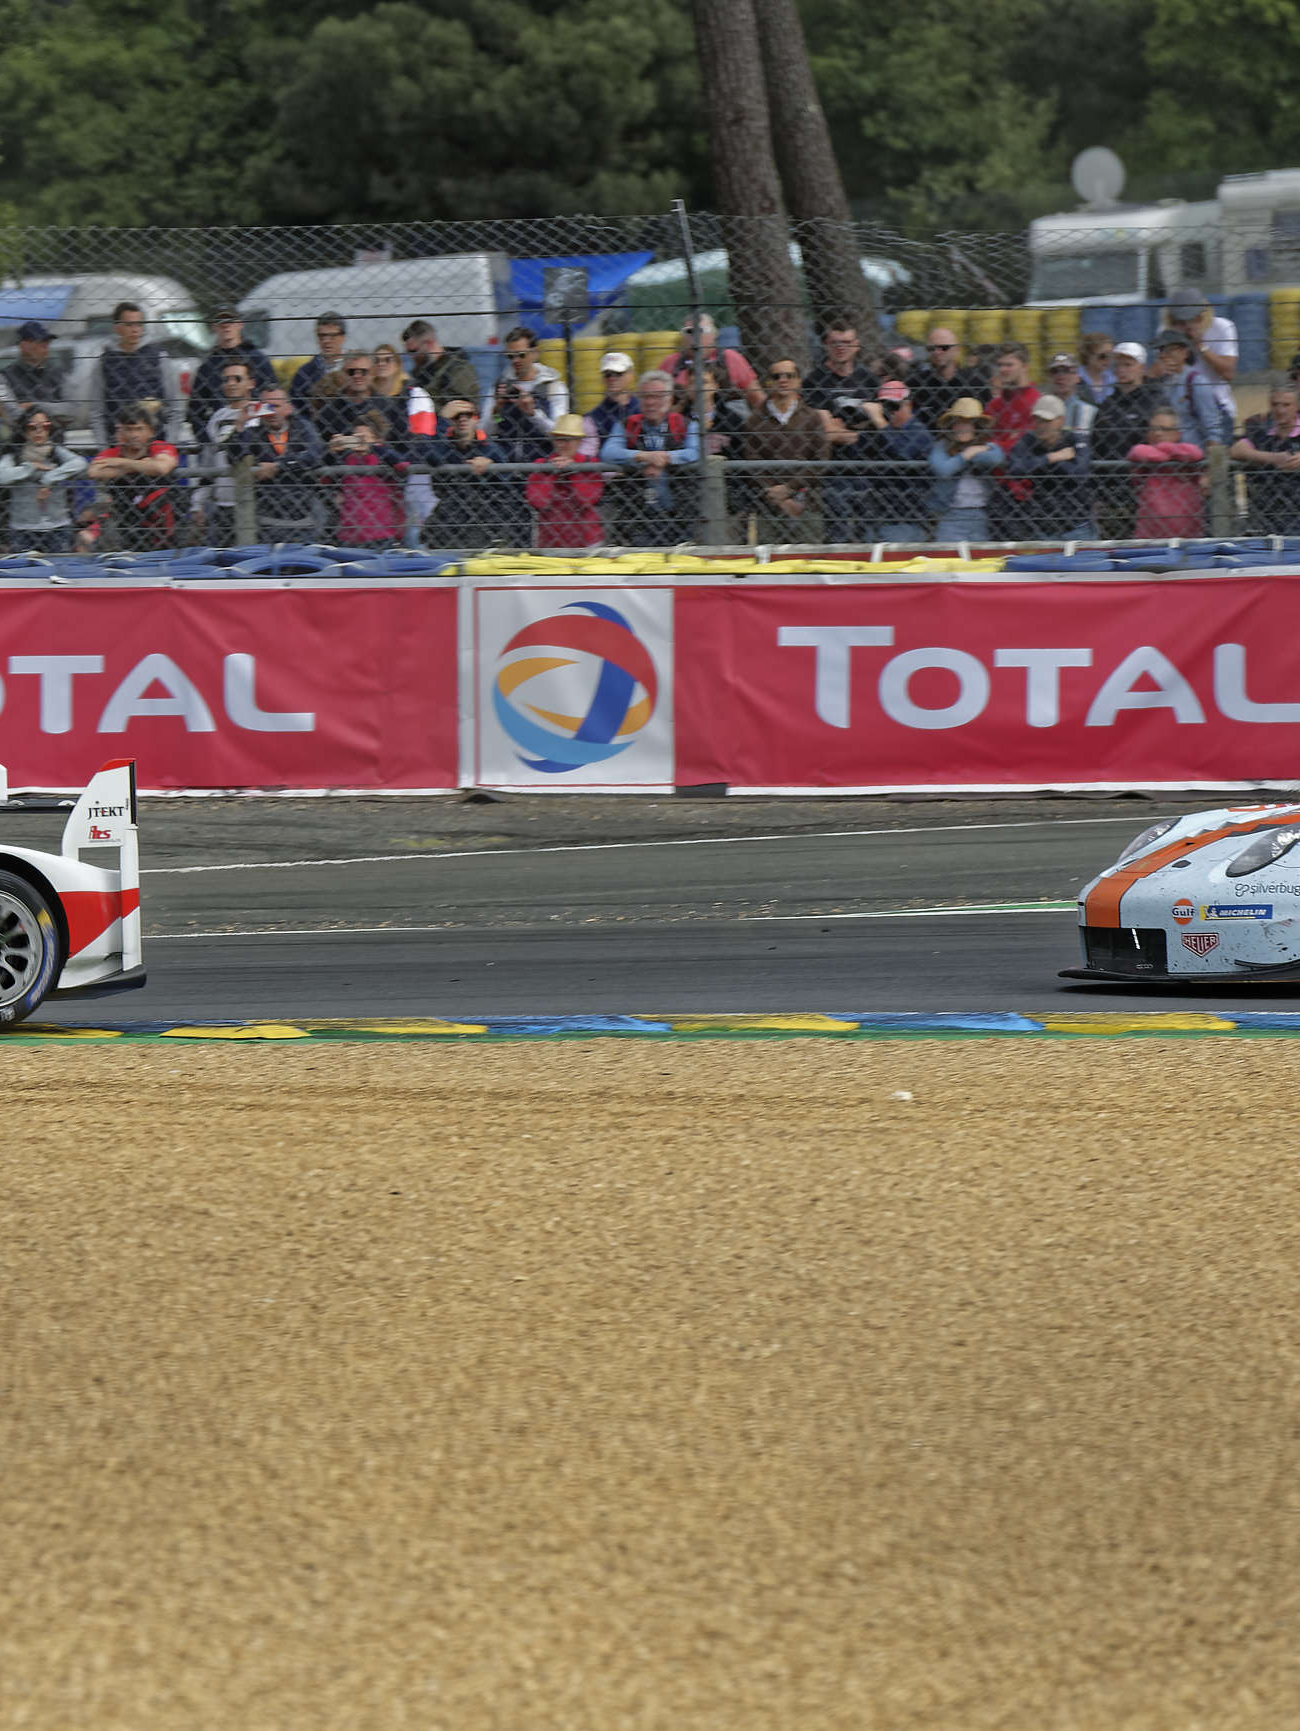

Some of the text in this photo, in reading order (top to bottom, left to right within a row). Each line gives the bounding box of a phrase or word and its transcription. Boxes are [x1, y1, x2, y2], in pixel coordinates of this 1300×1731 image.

[777, 626, 1300, 730] TOTAL
[87, 806, 125, 820] JTEKT
[1172, 907, 1196, 917] Gulf
[1181, 936, 1217, 953] HEUER
